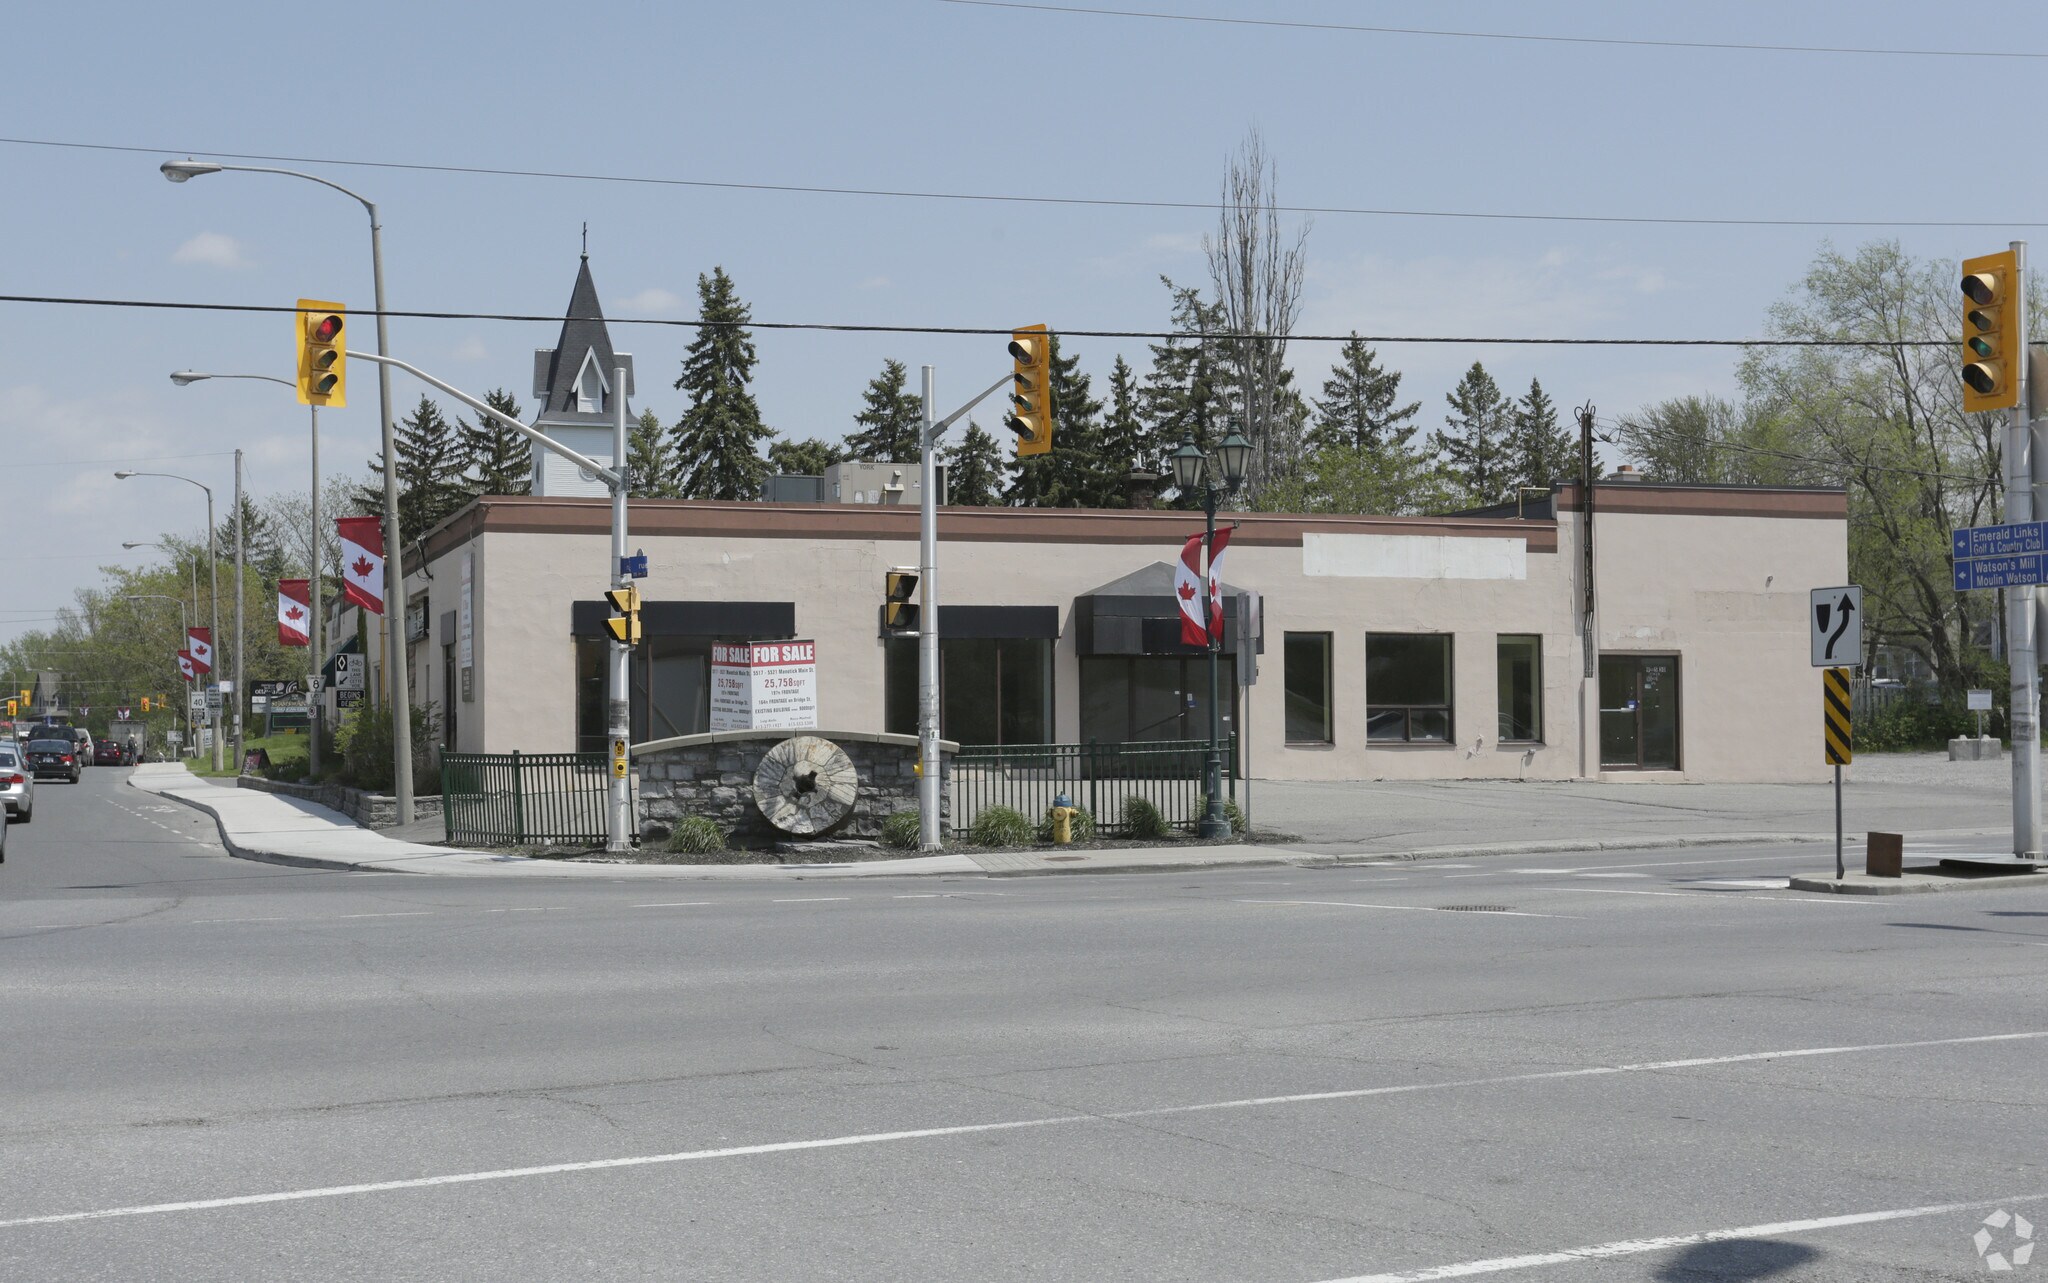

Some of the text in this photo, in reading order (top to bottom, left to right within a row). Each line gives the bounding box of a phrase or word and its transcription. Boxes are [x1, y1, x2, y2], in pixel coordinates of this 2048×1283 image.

[1973, 526, 2038, 542] Emerald Links
[1974, 538, 2040, 555] Golf & Country Club
[1975, 557, 2035, 573] Watson's Mill
[1976, 574, 2004, 586] Moulin
[2006, 572, 2038, 584] Watson
[712, 646, 750, 663] FOR SALE
[754, 644, 814, 663] FOR SALE
[313, 680, 319, 689] 8
